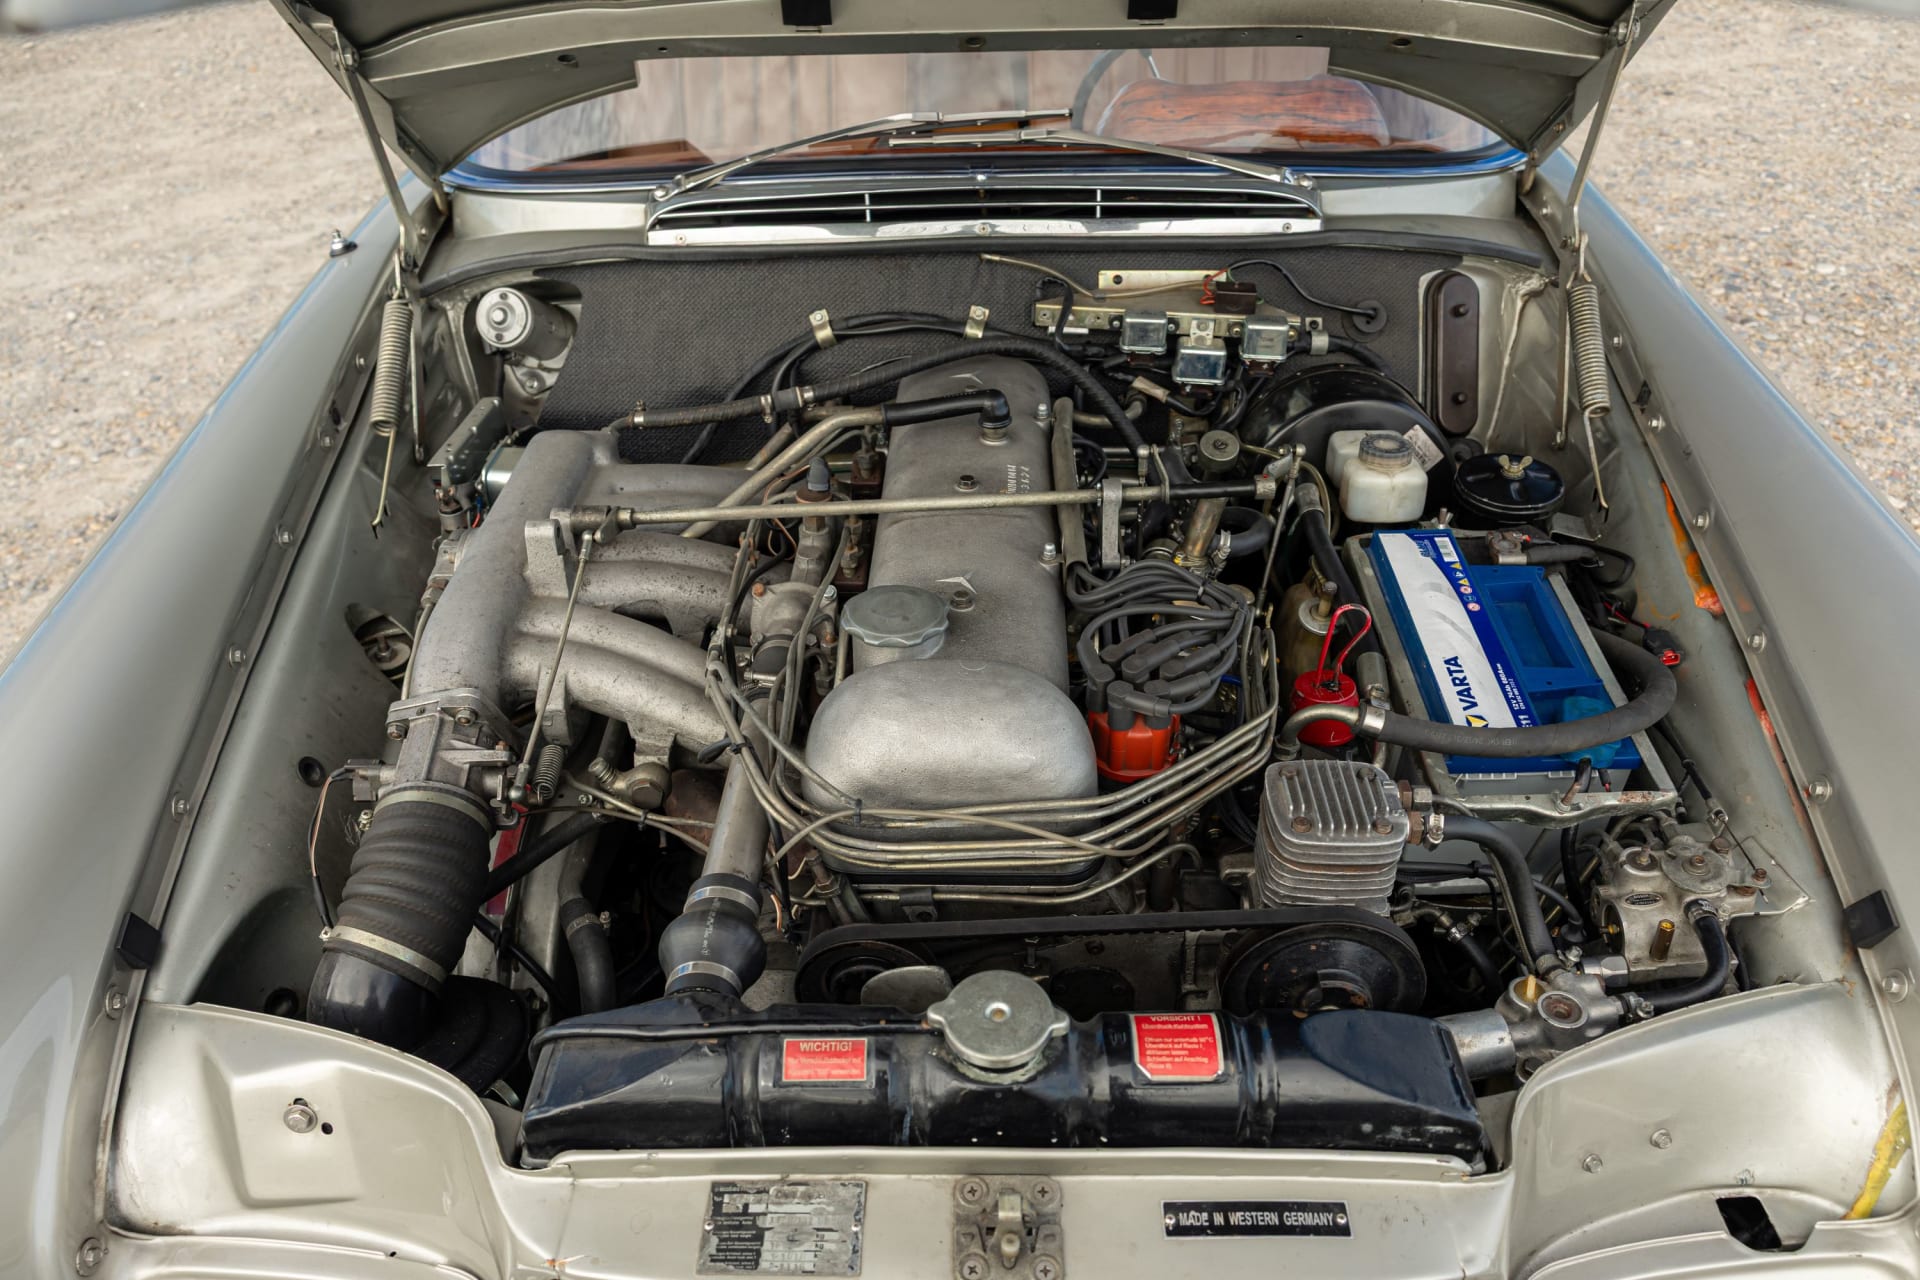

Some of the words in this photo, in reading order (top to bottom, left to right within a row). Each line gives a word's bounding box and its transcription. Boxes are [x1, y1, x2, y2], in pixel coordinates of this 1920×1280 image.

[1444, 656, 1478, 711] VARTA
[799, 1041, 853, 1052] WICHTIG!
[1179, 1212, 1209, 1226] MADE
[1213, 1212, 1224, 1226] IN
[1228, 1211, 1279, 1226] WESTERN
[1283, 1211, 1334, 1226] GERMANY
